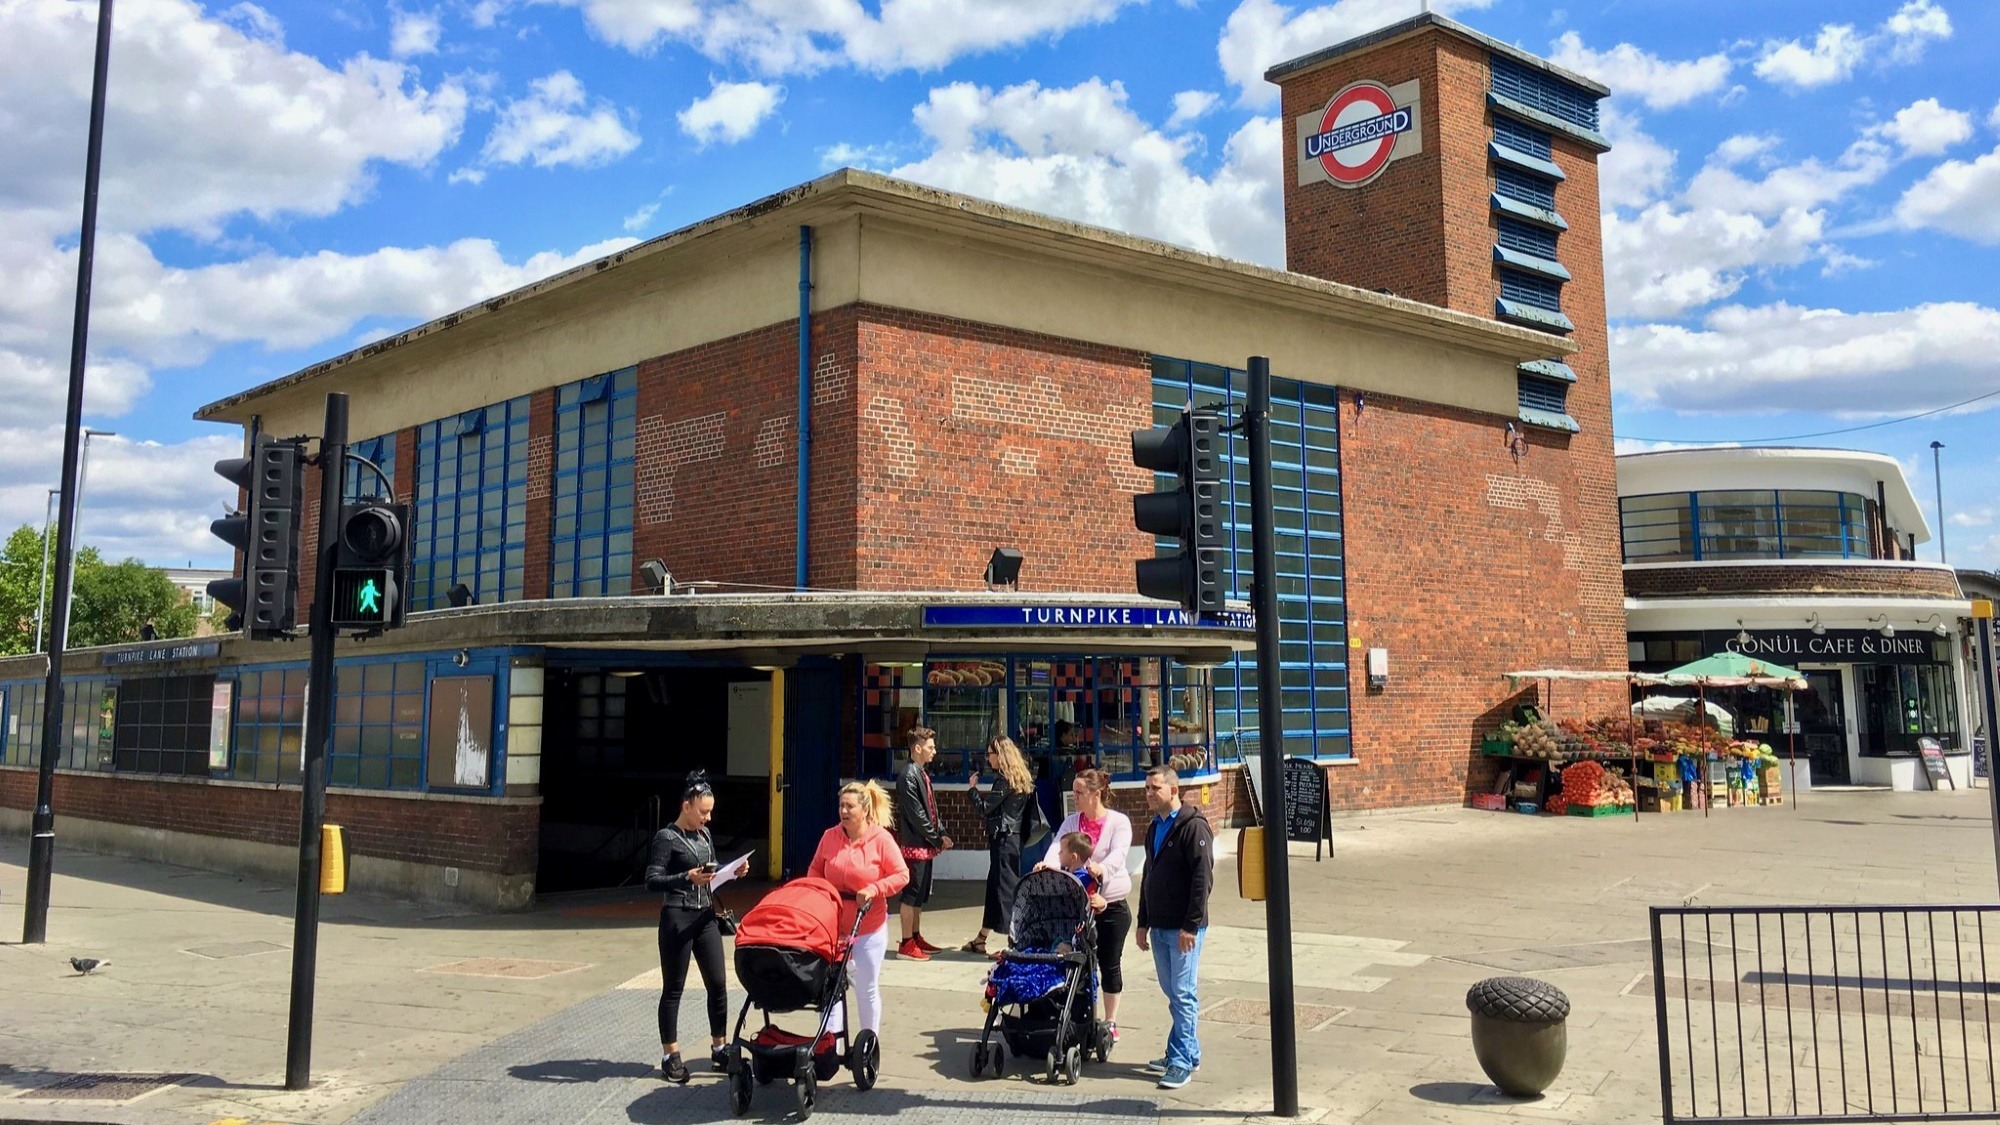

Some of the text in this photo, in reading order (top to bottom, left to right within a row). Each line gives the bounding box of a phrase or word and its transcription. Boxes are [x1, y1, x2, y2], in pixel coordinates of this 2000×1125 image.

[1308, 111, 1408, 155] UNDERGROUND
[1022, 608, 1131, 624] TURNPIKE
[1156, 609, 1190, 625] LAN
[1725, 635, 1925, 654] GÖNÜL CAFE & DINER
[117, 645, 198, 663] TURNPIKE LANE STATION
